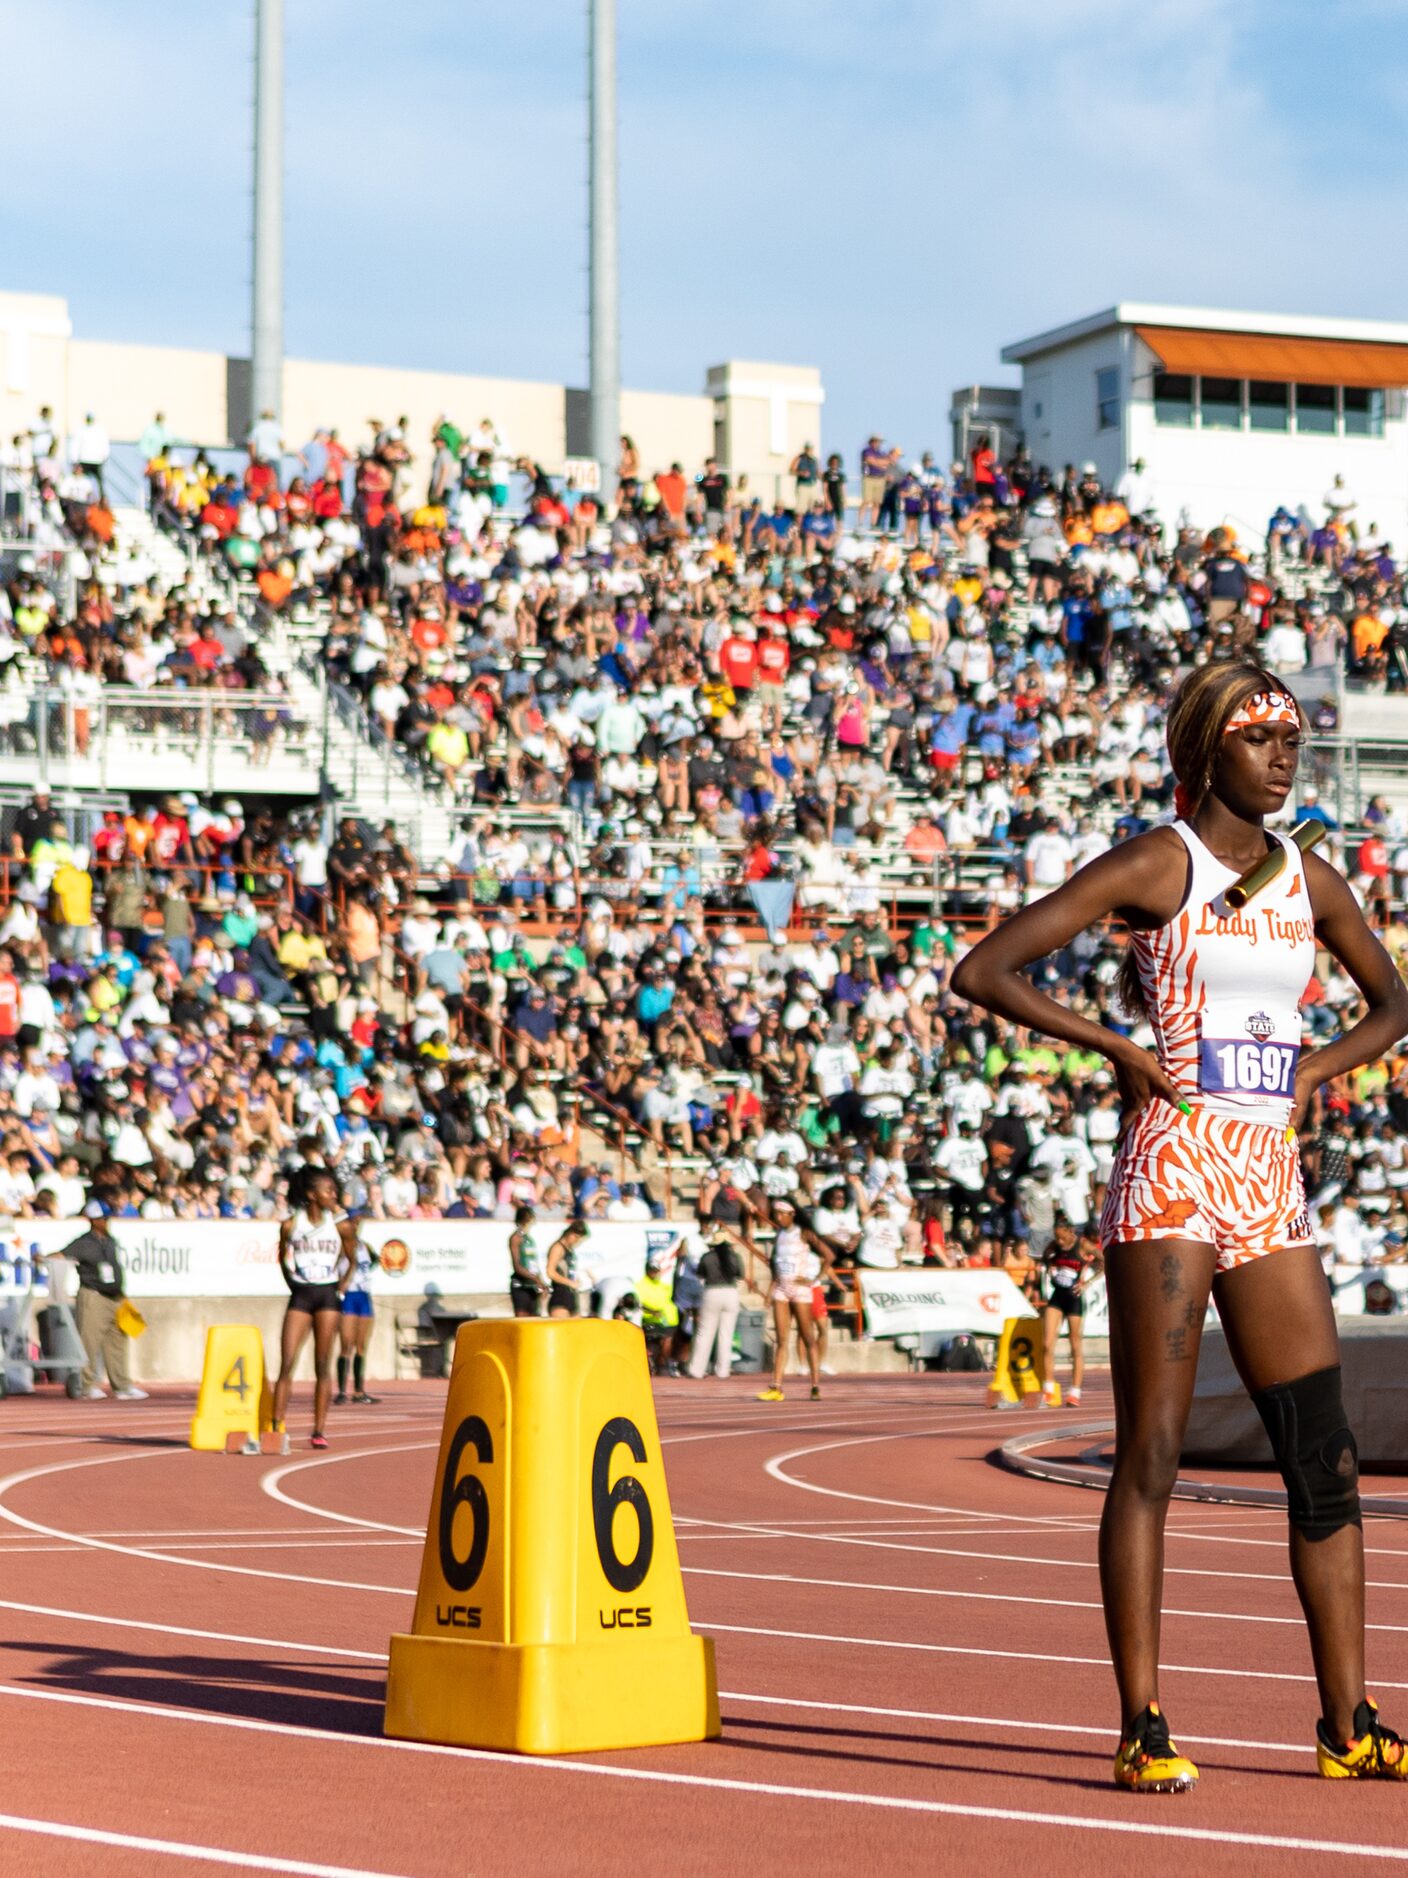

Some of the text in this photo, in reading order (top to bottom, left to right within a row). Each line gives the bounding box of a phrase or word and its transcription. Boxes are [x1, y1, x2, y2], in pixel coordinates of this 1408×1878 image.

[1195, 902, 1258, 946] Lady
[1244, 1020, 1276, 1034] STATE
[1216, 1043, 1294, 1092] 1697
[1010, 1336, 1035, 1373] 3
[223, 1355, 250, 1403] 4
[438, 1414, 494, 1592] 6
[591, 1416, 654, 1593] 6
[436, 1605, 483, 1629] UCS
[599, 1606, 652, 1629] UCS
